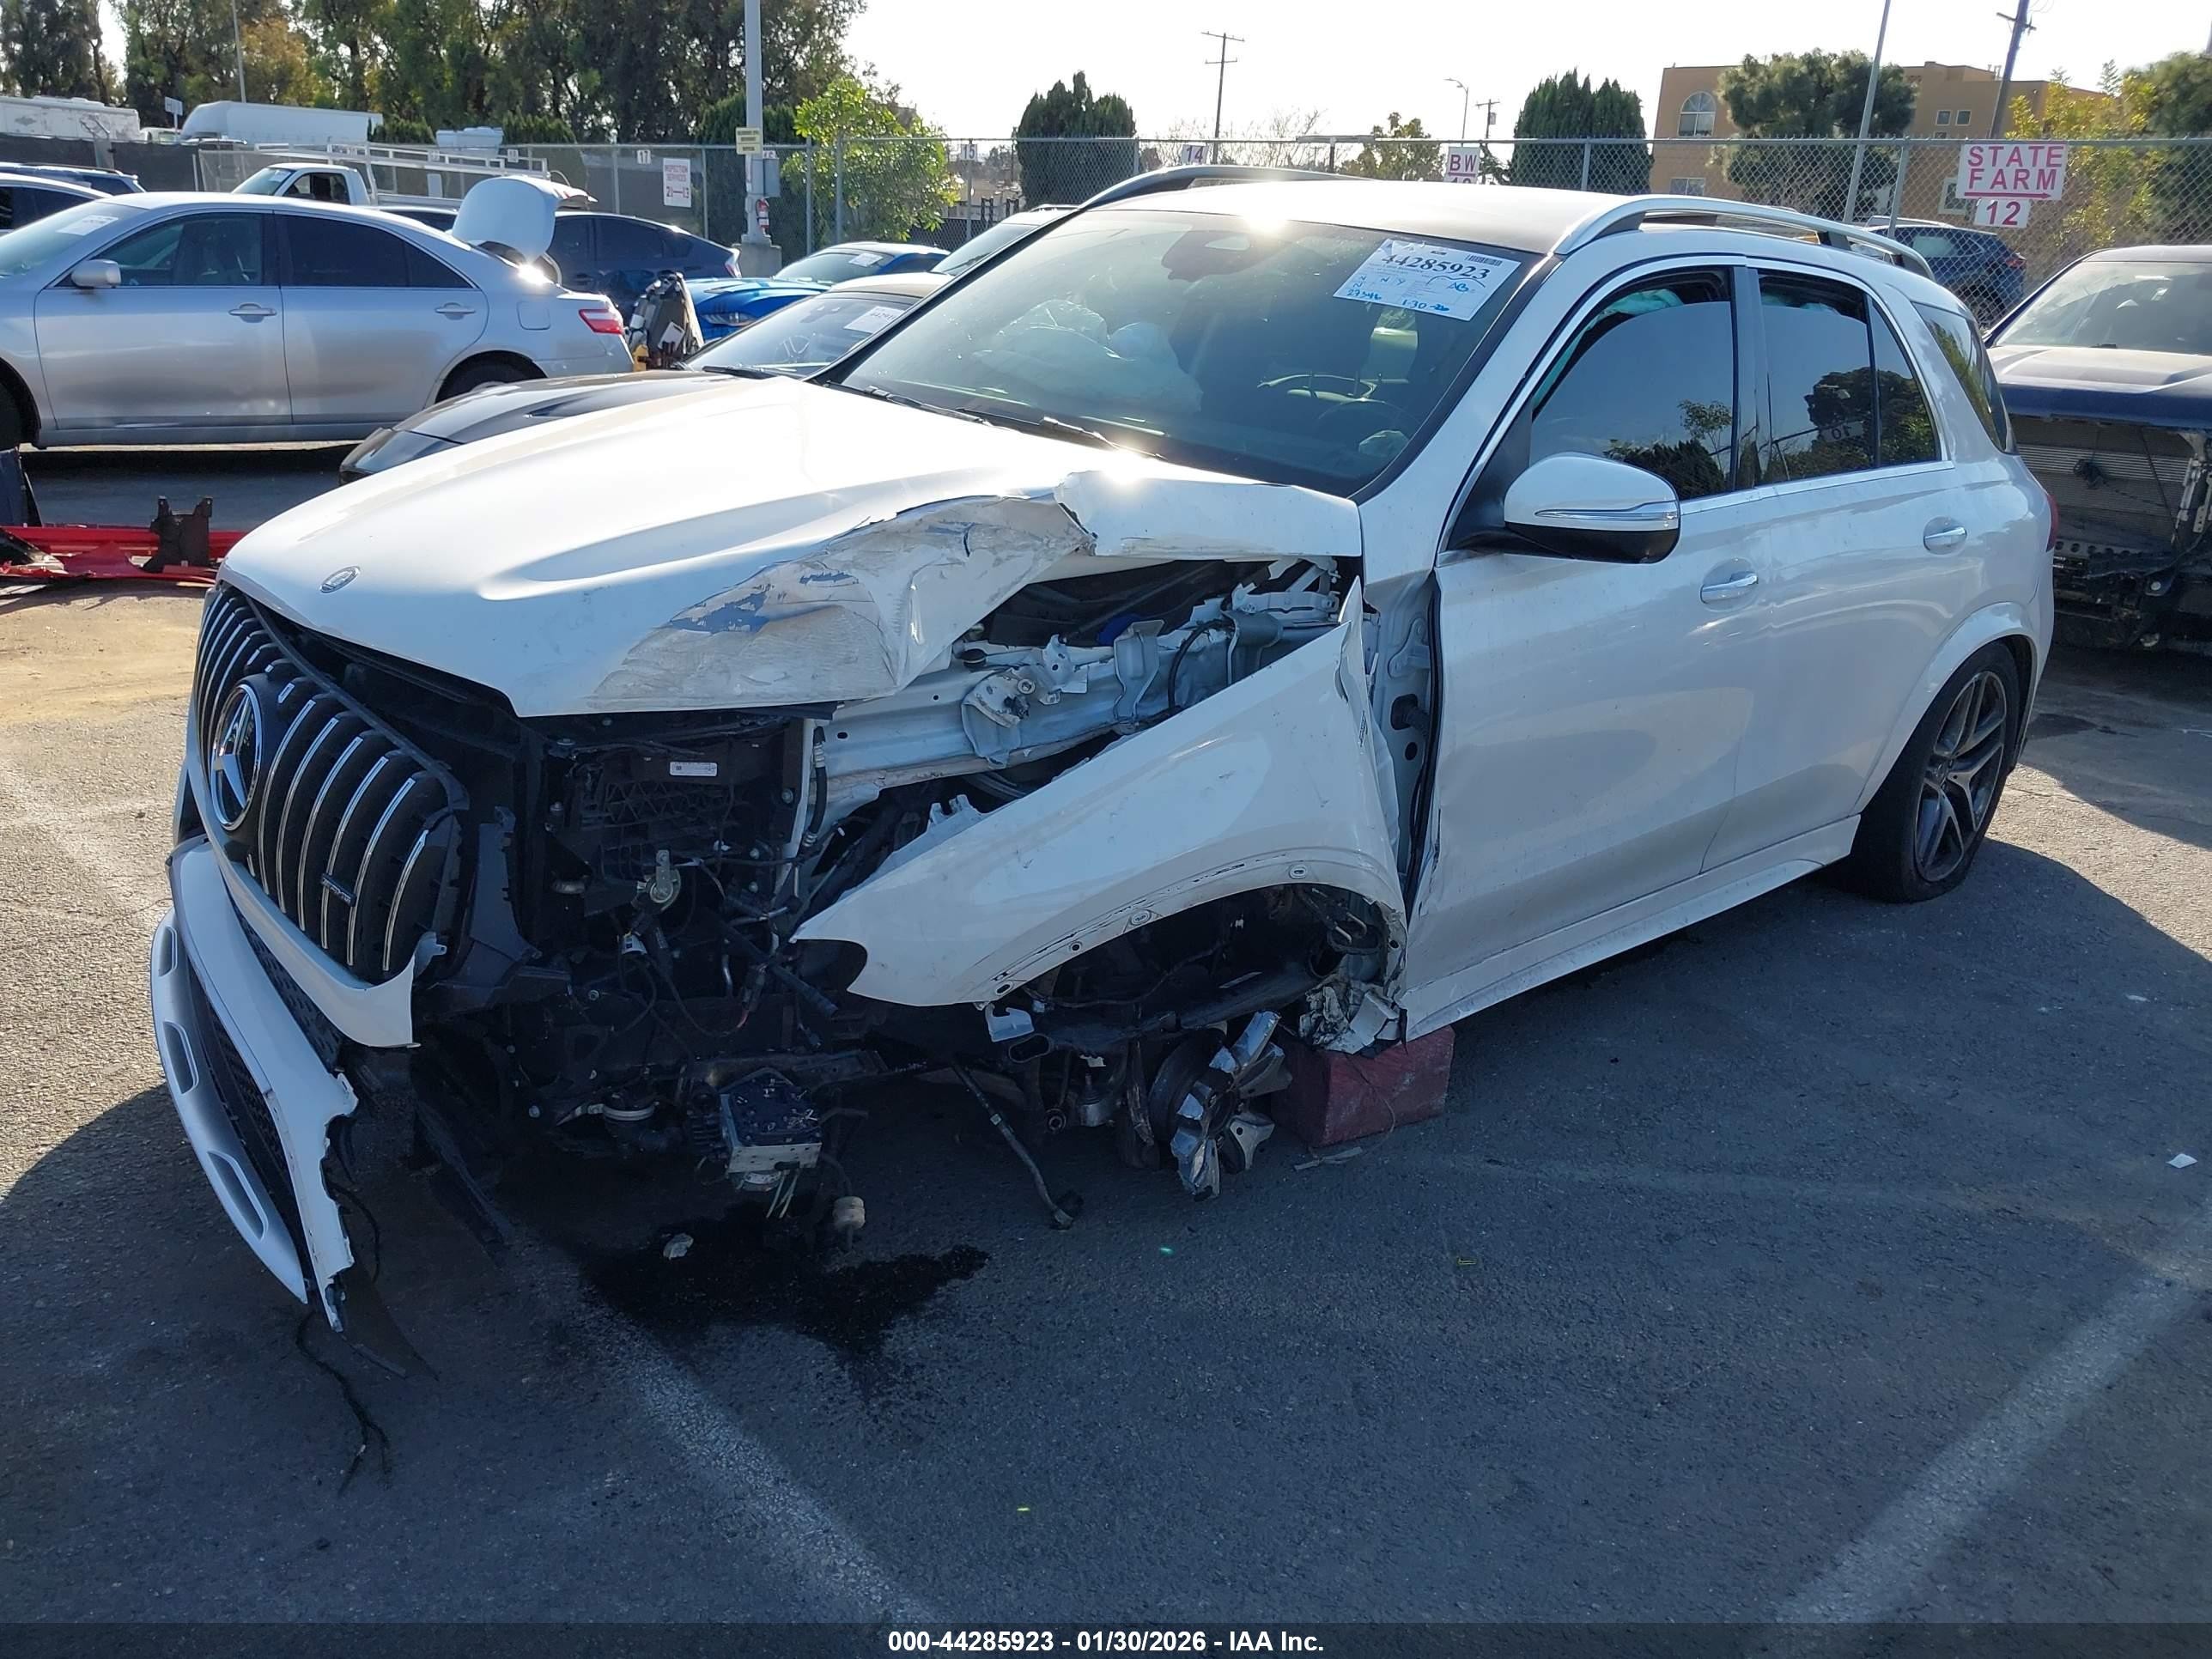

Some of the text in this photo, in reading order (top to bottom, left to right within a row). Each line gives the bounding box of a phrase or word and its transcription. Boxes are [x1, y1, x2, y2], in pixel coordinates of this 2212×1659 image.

[963, 144, 975, 160] 15
[1186, 145, 1204, 163] 14
[1967, 146, 2064, 167] STATE
[1449, 155, 1477, 172] BW
[1968, 168, 2057, 190] FARM
[1986, 200, 2021, 225] 12
[1381, 254, 1491, 279] 44285923
